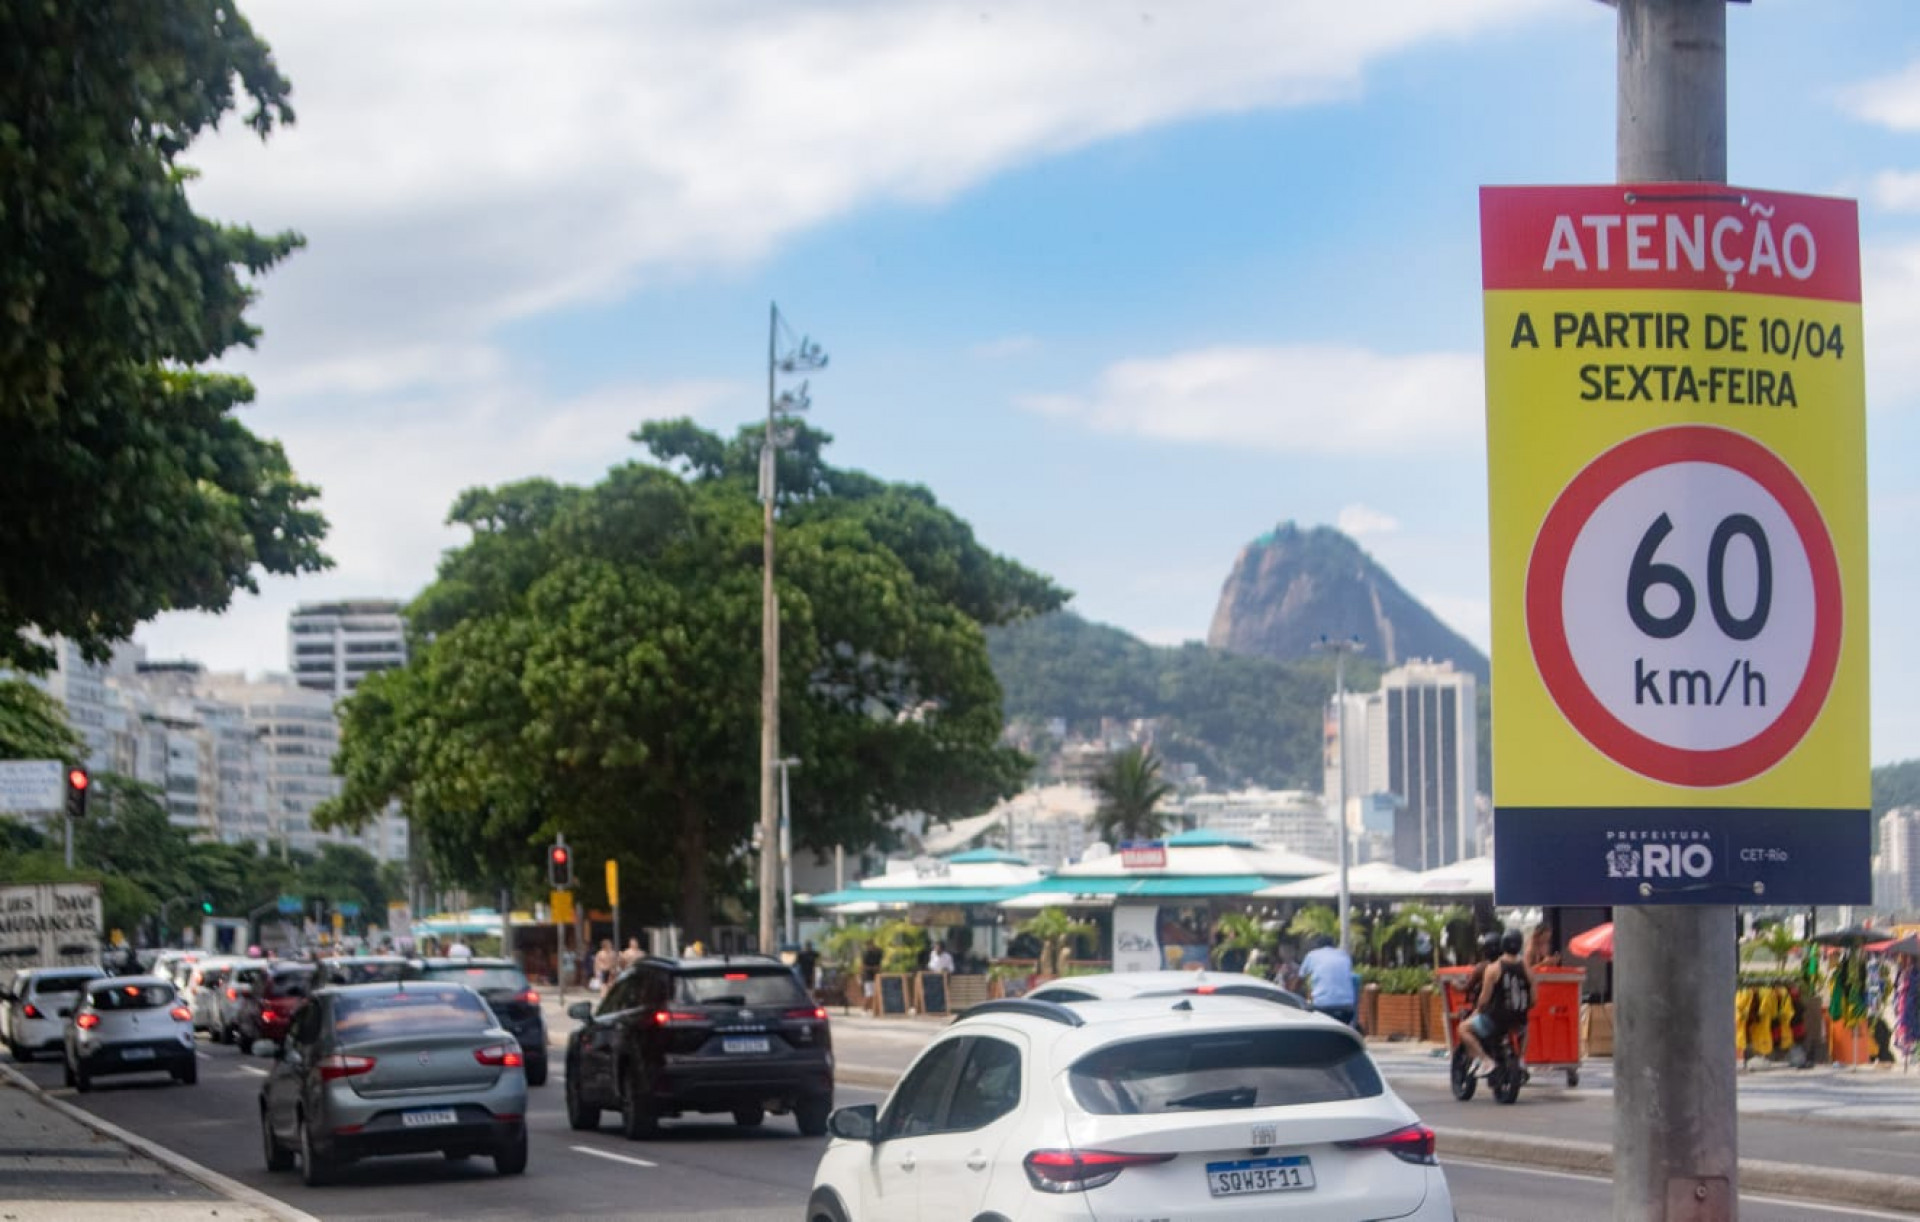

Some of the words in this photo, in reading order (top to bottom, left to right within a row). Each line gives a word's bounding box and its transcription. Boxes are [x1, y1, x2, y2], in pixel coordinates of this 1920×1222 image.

[1542, 203, 1817, 289] ATENÇÃO
[1510, 313, 1539, 349] A
[1553, 312, 1690, 350] PARTIR
[1704, 315, 1748, 352] DE
[1759, 317, 1845, 360] 10/04
[1579, 364, 1798, 409] SEXTA-FEIRA
[1626, 511, 1773, 641] 60
[1634, 657, 1767, 707] km/h
[1605, 831, 1711, 840] PREFEITURA
[1739, 848, 1789, 862] CET-Rio
[1642, 843, 1714, 878] RIO
[1218, 1168, 1303, 1192] SQW3F11
